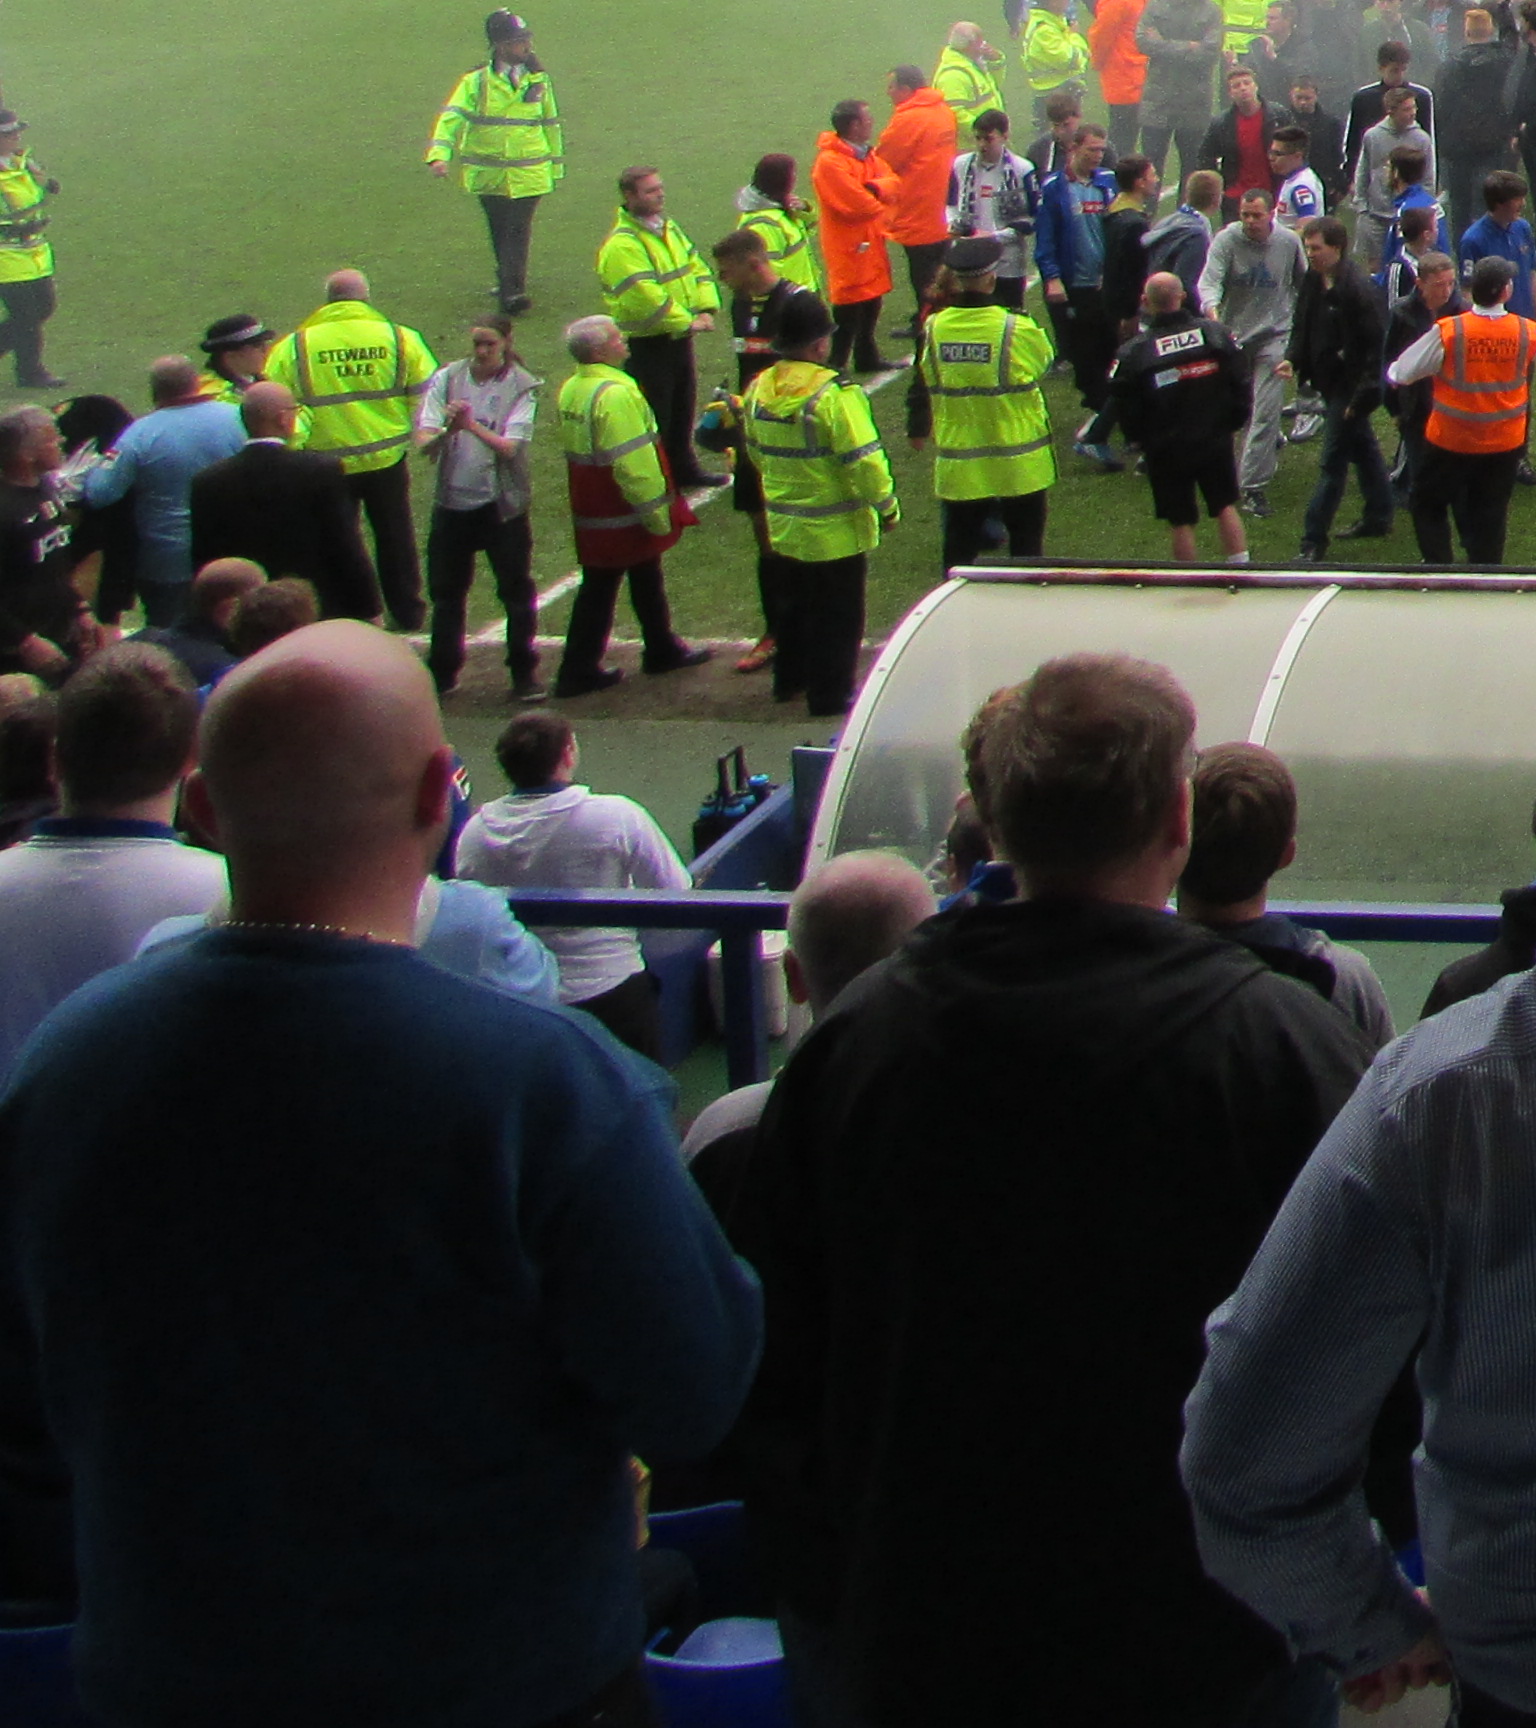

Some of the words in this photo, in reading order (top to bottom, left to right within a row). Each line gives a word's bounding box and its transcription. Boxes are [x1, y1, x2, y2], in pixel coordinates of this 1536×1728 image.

[1161, 333, 1200, 353] FILA
[317, 346, 388, 364] STEWARD
[941, 344, 990, 362] POLICE
